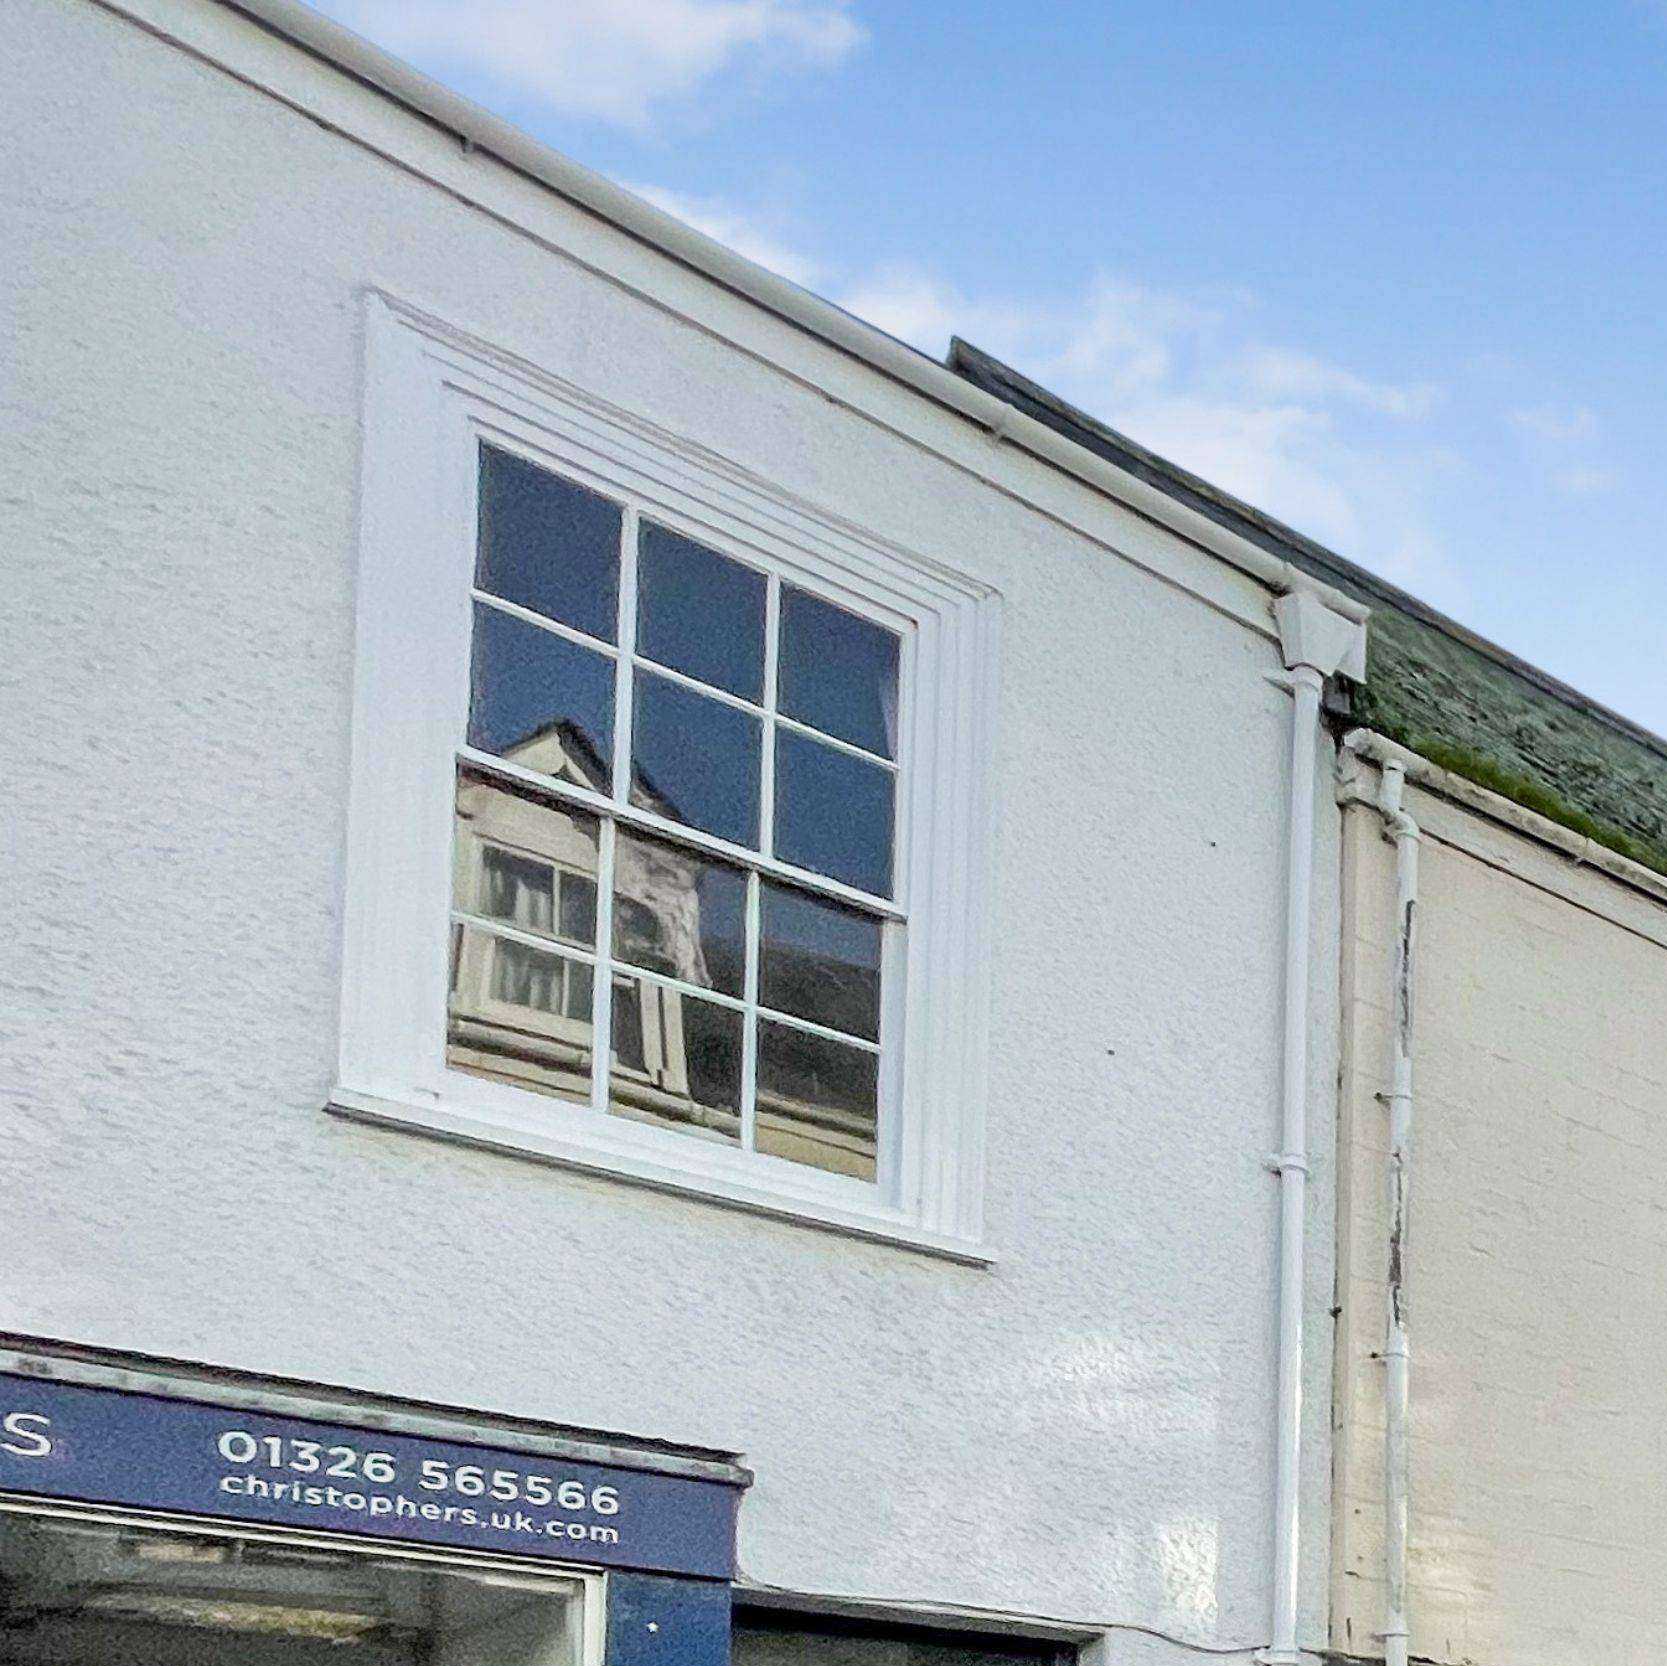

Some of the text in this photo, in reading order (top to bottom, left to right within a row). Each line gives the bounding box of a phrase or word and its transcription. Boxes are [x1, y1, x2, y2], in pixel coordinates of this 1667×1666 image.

[217, 1430, 620, 1515] 01326 565566
[219, 1473, 619, 1544] christophers.uk.com
